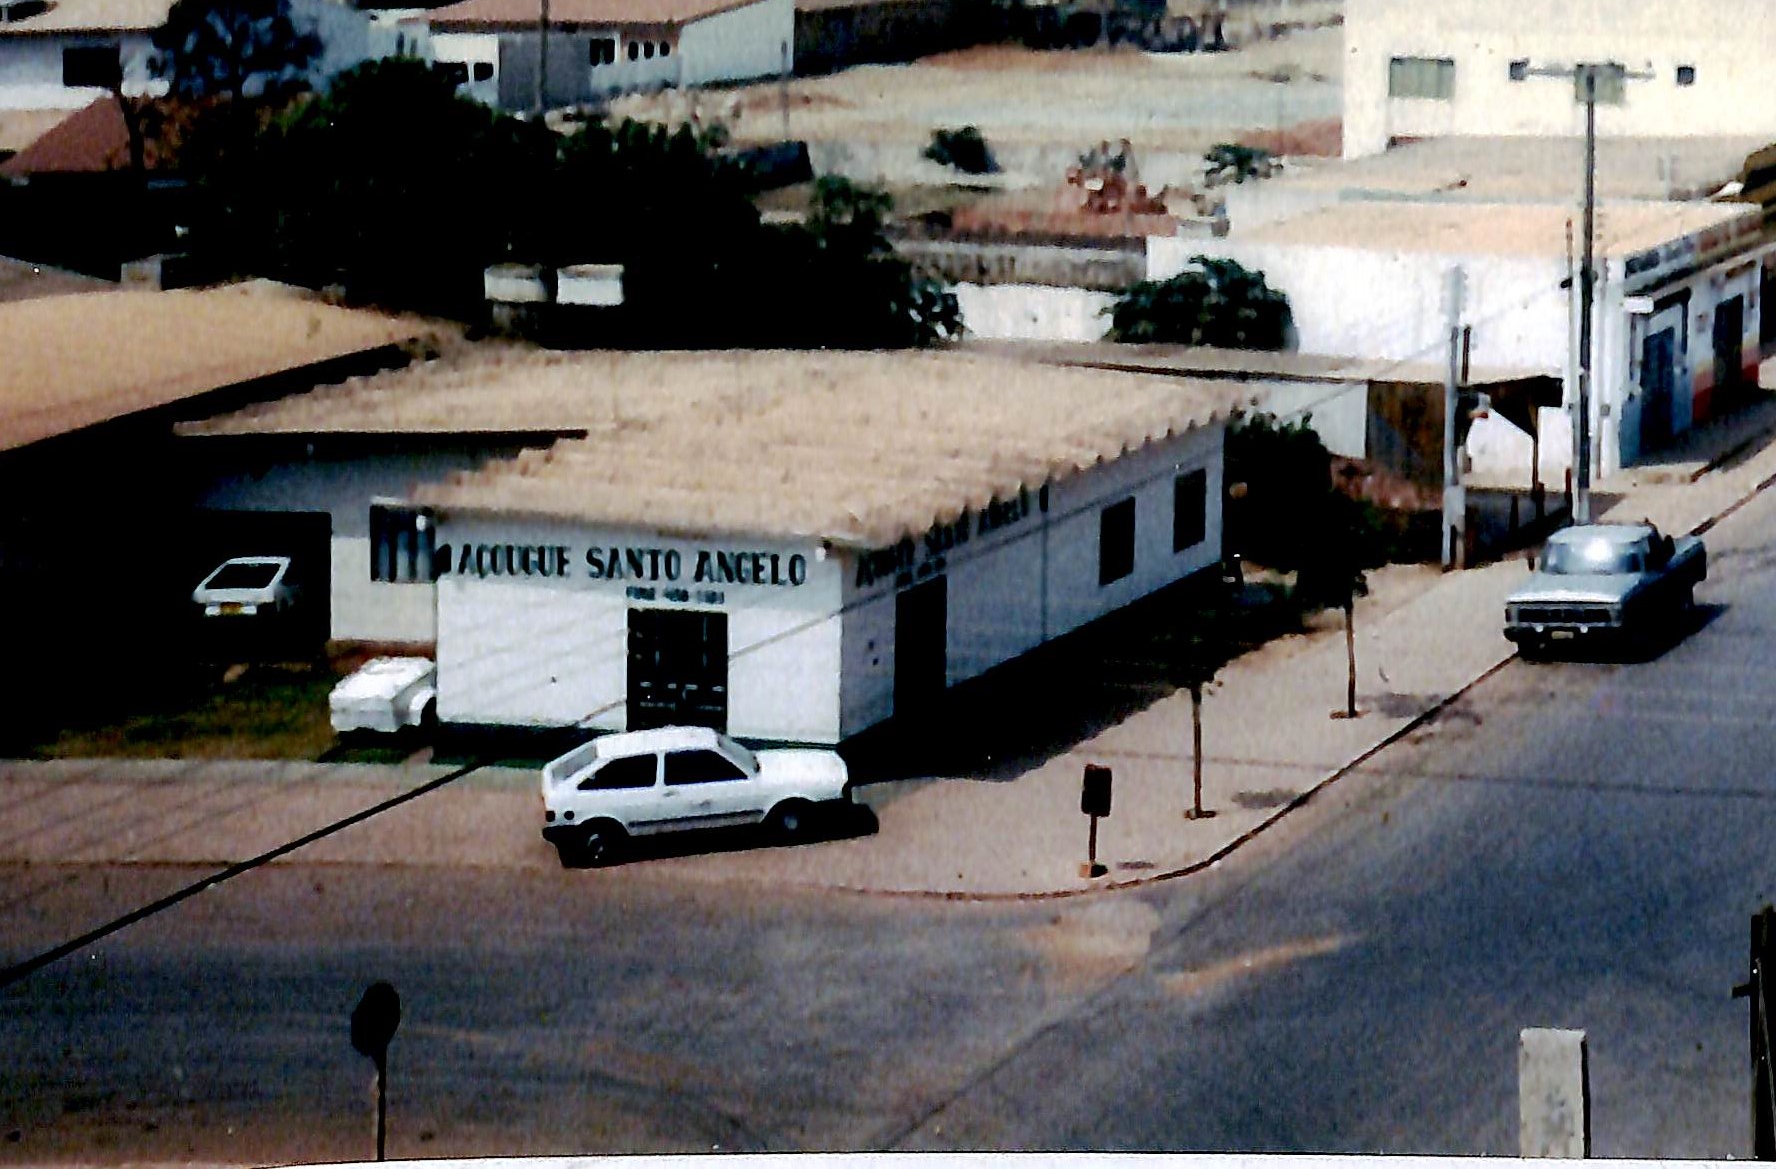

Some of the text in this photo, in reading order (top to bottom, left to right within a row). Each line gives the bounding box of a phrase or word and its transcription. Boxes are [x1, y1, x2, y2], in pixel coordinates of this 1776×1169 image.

[457, 542, 806, 586] AÇOUGUE SANTO ANGELO
